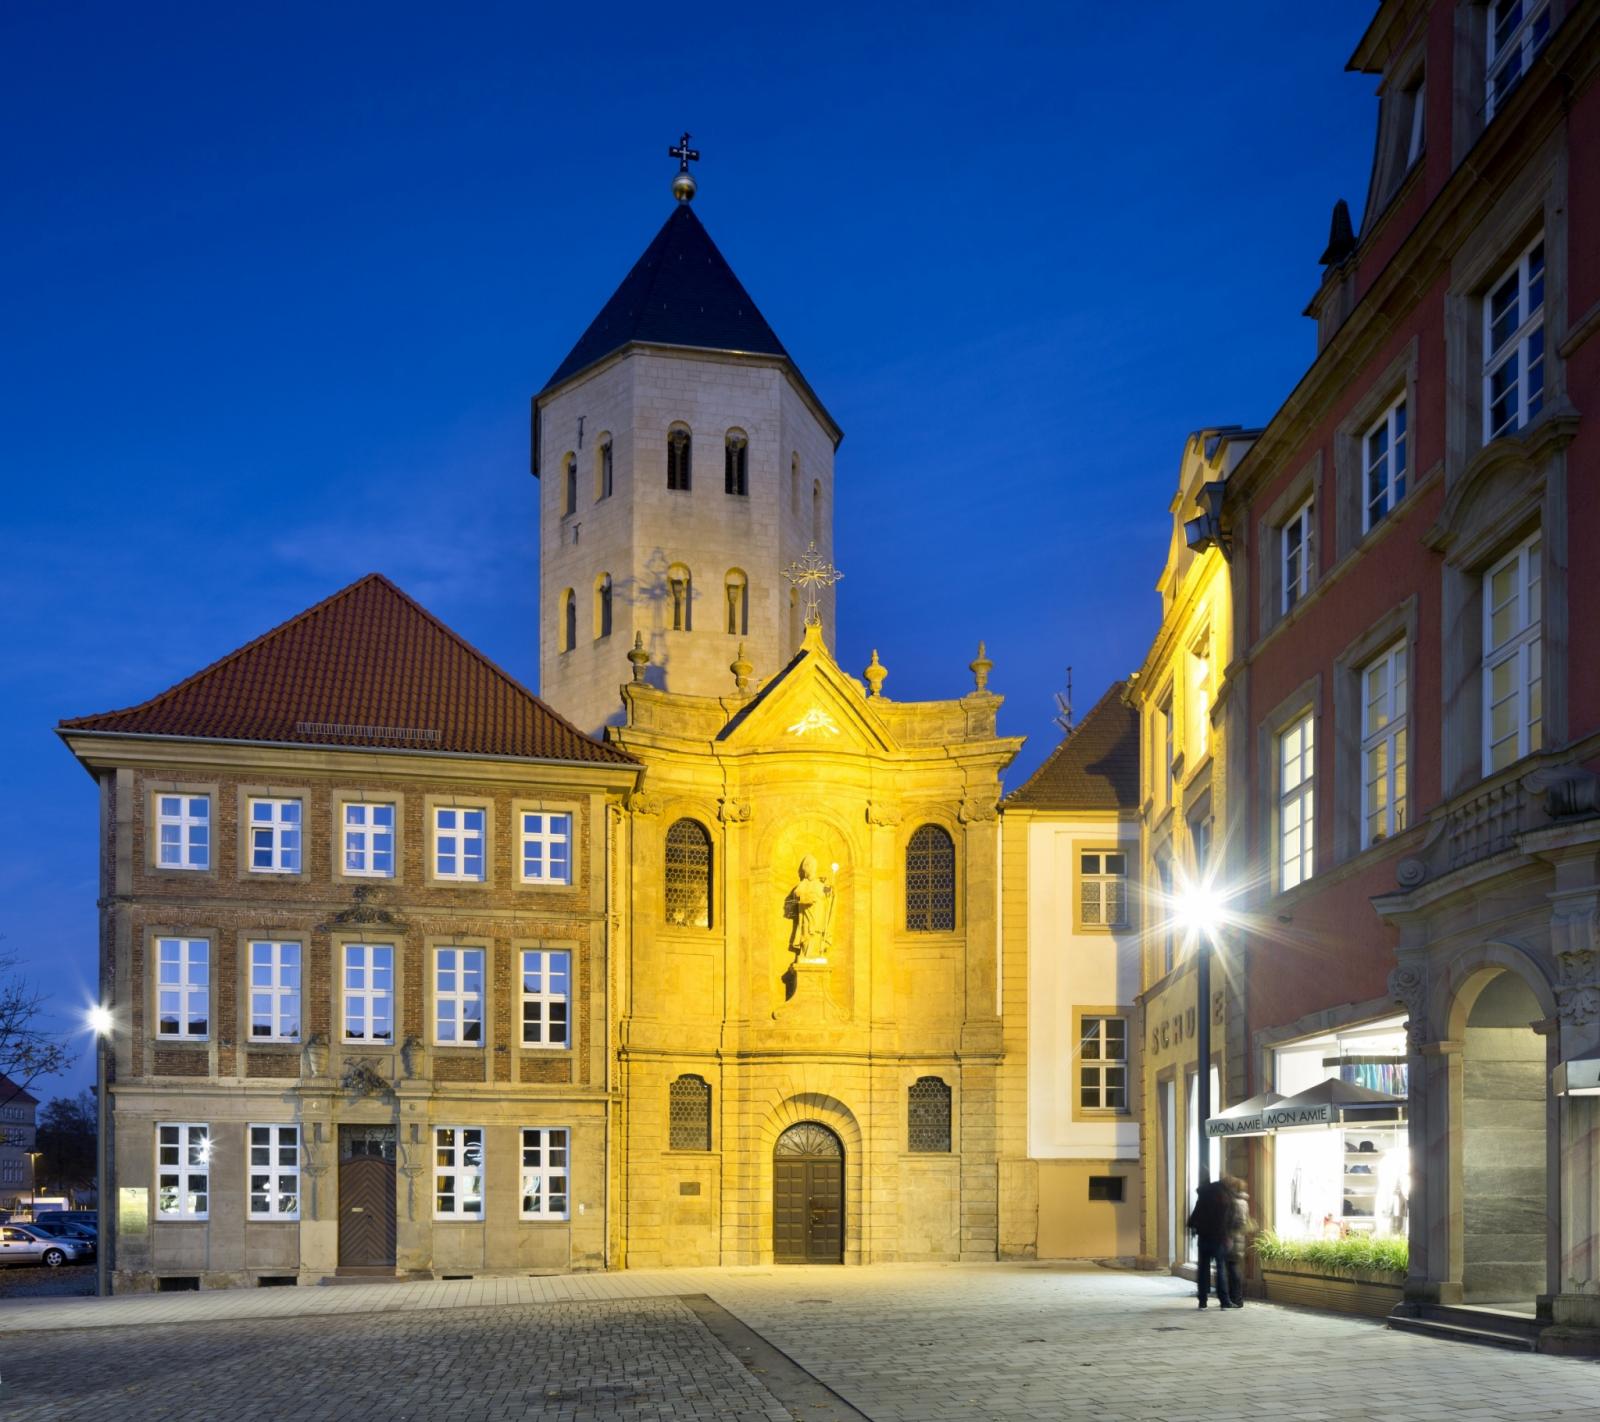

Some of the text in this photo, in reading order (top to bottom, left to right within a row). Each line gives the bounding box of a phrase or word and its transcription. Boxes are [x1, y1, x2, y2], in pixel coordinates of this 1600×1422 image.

[1151, 990, 1224, 1055] SCHUE
[1267, 1108, 1327, 1125] MON AMIE
[1209, 1119, 1260, 1134] MON AMIE
